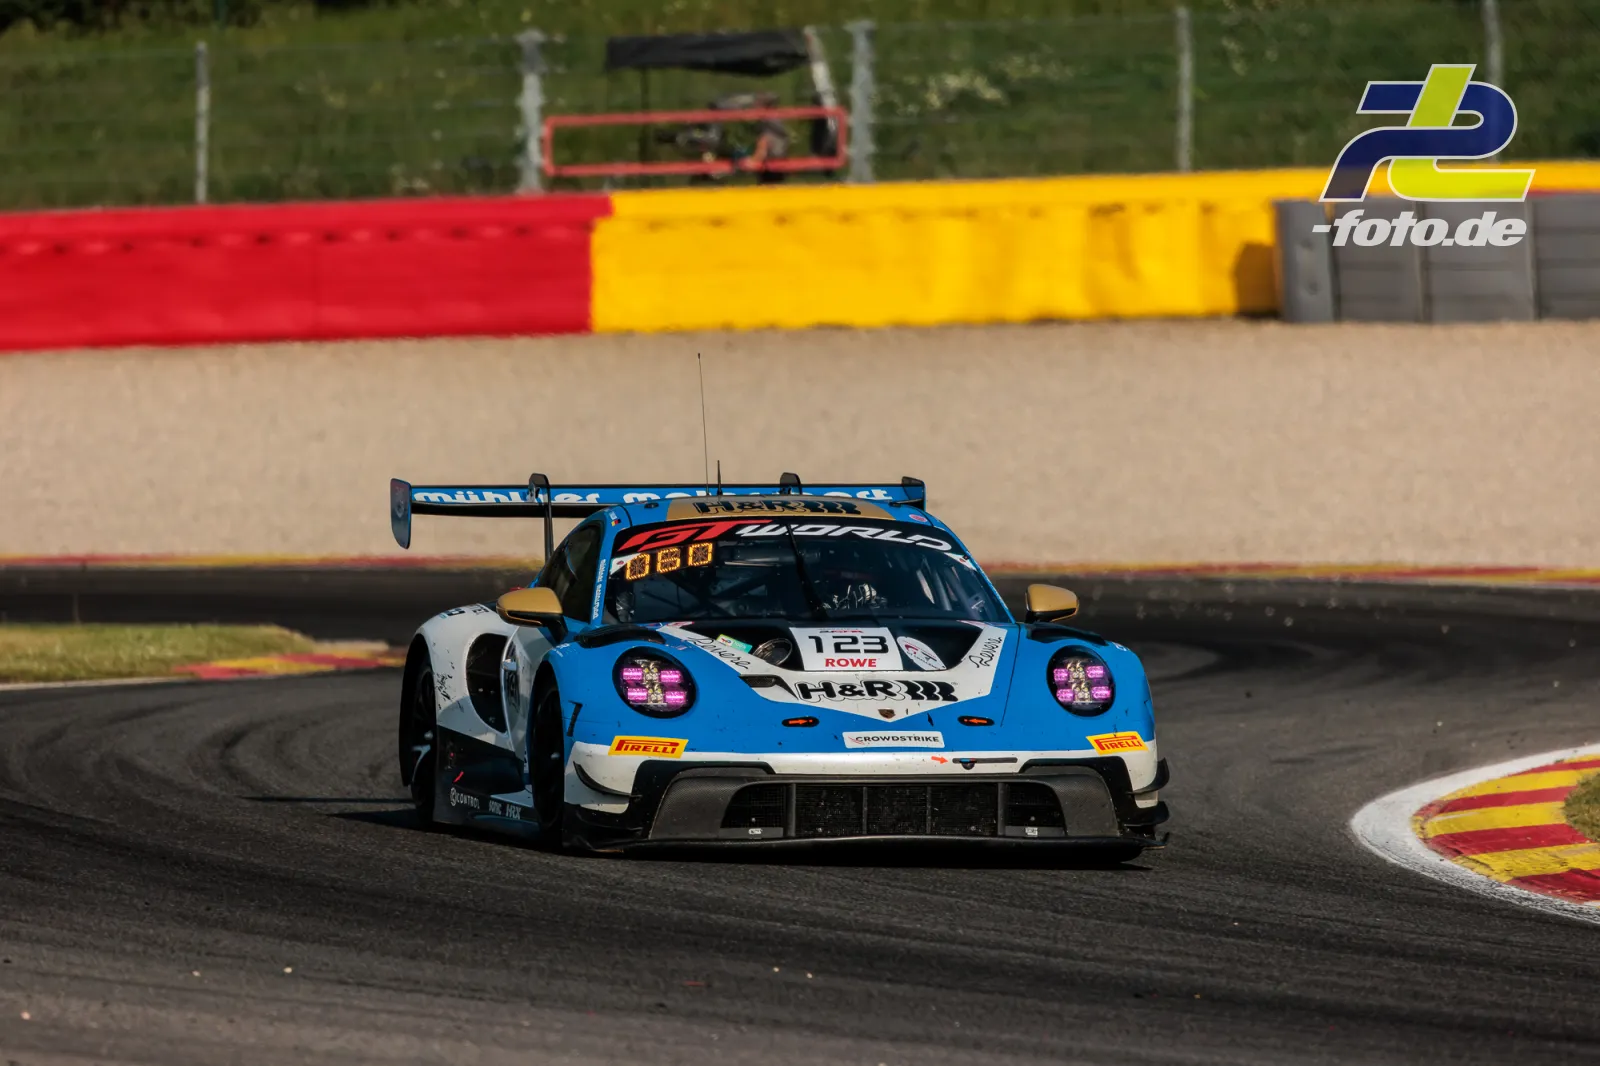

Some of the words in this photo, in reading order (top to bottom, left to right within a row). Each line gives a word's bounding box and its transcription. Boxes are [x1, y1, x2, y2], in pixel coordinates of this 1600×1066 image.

[617, 519, 773, 552] GT
[735, 524, 952, 551] WORLD
[808, 635, 889, 654] 123
[824, 658, 877, 668] ROWE
[614, 739, 680, 755] PIRELLI
[855, 734, 940, 744] CROWDSTRIKE
[1093, 735, 1143, 751] PIRELLI
